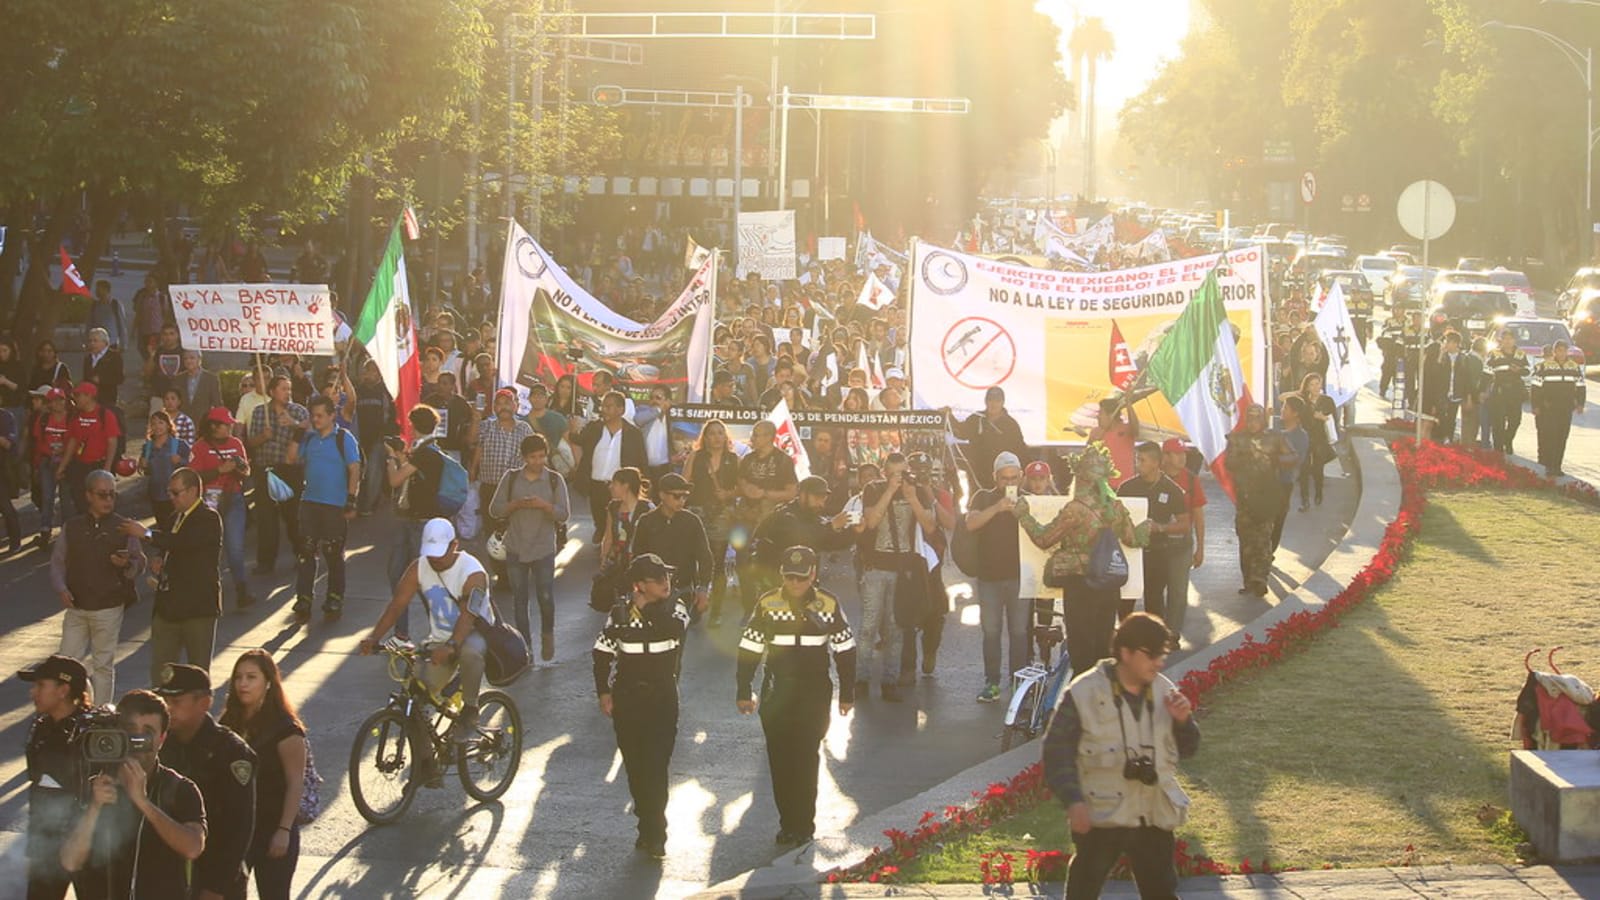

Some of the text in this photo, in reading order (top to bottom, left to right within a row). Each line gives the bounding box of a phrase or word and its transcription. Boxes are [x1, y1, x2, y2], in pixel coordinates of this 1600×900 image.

[976, 251, 1258, 285] EJERCITO MEXICANO: EL ENEIGO
[1001, 276, 1025, 286] NO
[1029, 281, 1050, 290] ES
[1056, 284, 1076, 293] EL
[1156, 277, 1176, 286] ES
[1181, 272, 1202, 282] EL
[196, 289, 300, 305] YA BASTA
[553, 289, 573, 307] NO
[571, 304, 582, 315] A
[989, 284, 1256, 311] NO A LA LEY DE SEGURIDAD IRIOR
[242, 305, 262, 321] DE
[187, 318, 325, 339] DOLOR Y MUERTE
[230, 337, 257, 351] DEL
[669, 407, 683, 418] SE
[687, 409, 733, 420] SIENTEN
[736, 410, 758, 420] LOS
[761, 411, 805, 421] DOS
[807, 412, 821, 422] DE
